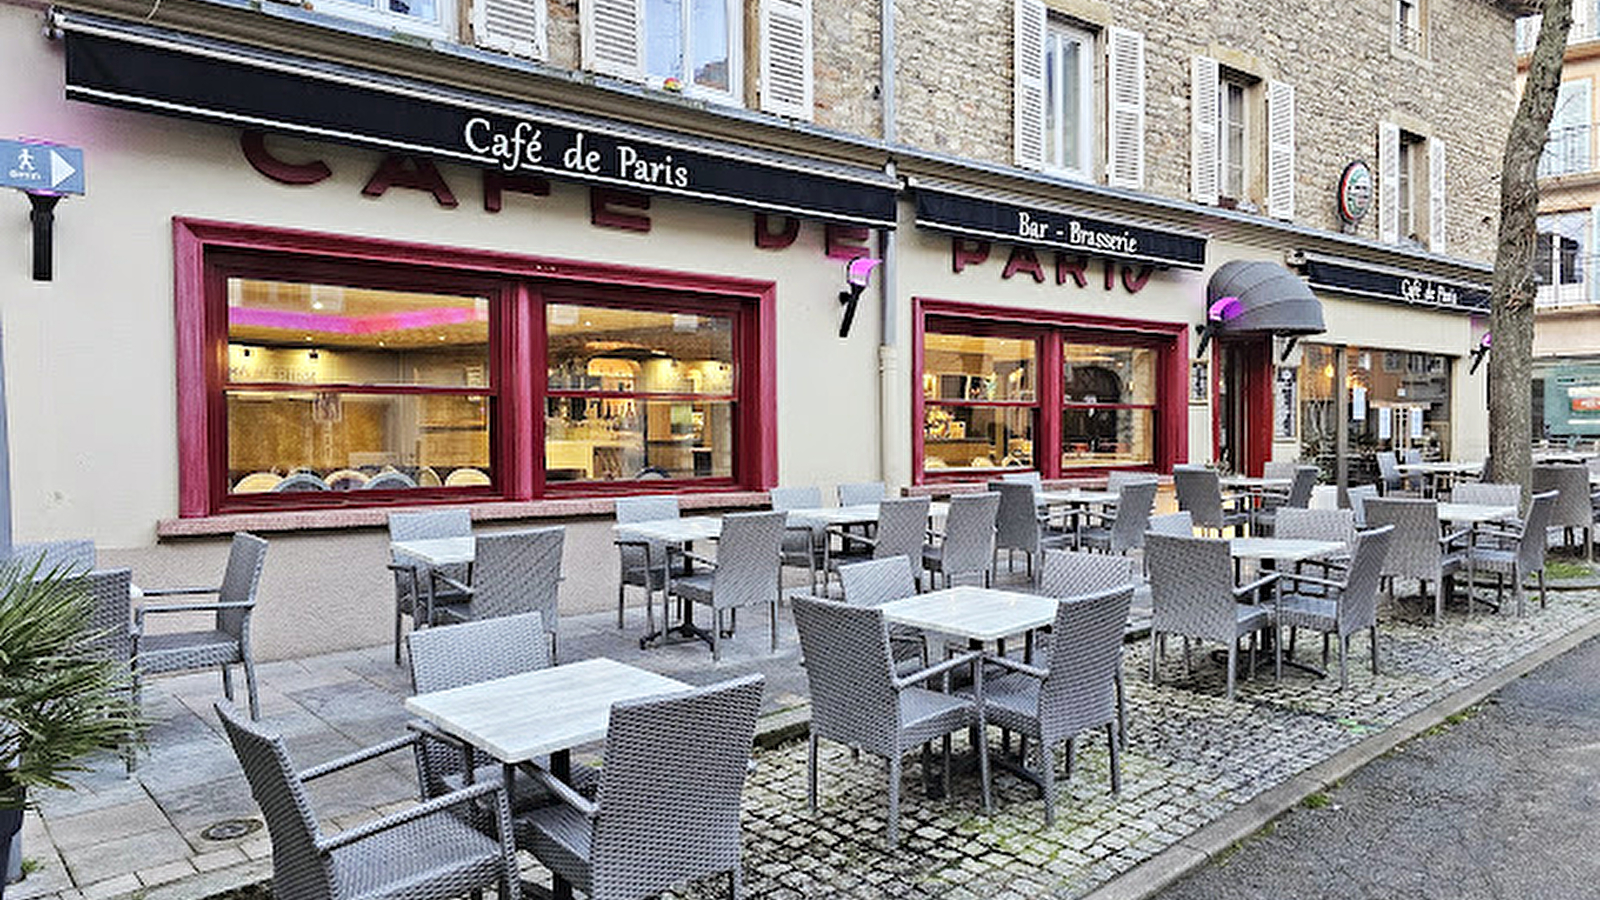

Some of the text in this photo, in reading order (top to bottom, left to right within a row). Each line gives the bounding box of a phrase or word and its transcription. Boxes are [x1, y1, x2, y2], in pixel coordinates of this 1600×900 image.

[465, 118, 688, 187] Café de Paris
[1019, 212, 1049, 239] Bar
[1069, 221, 1138, 253] Brasserie
